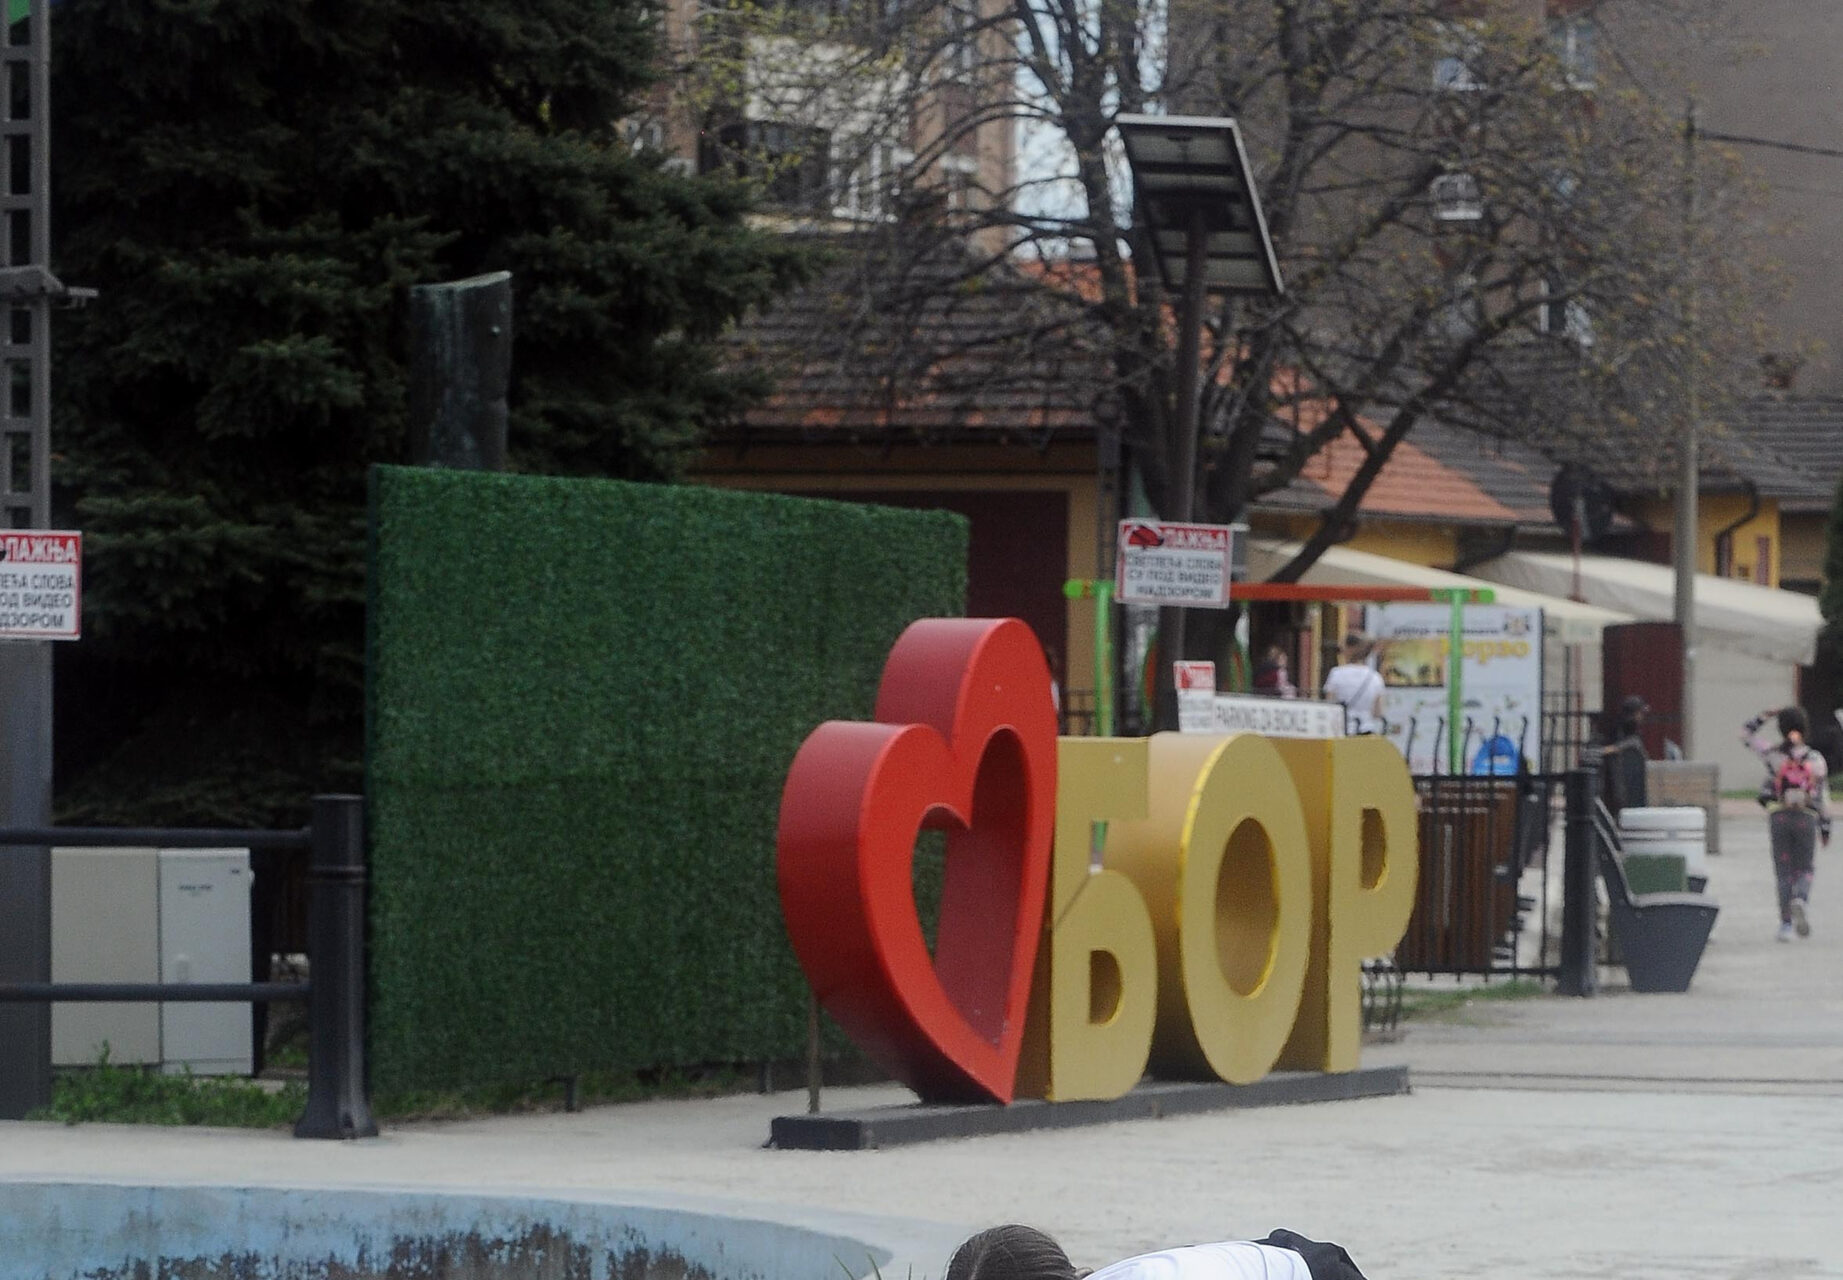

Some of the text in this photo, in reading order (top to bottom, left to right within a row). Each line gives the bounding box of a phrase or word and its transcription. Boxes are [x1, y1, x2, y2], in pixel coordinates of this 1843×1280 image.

[5, 537, 78, 562] ПАЖЊА
[32, 574, 73, 590] СЛОВА
[23, 592, 71, 609] ВИДЕО
[1051, 731, 1420, 1102] БОР
